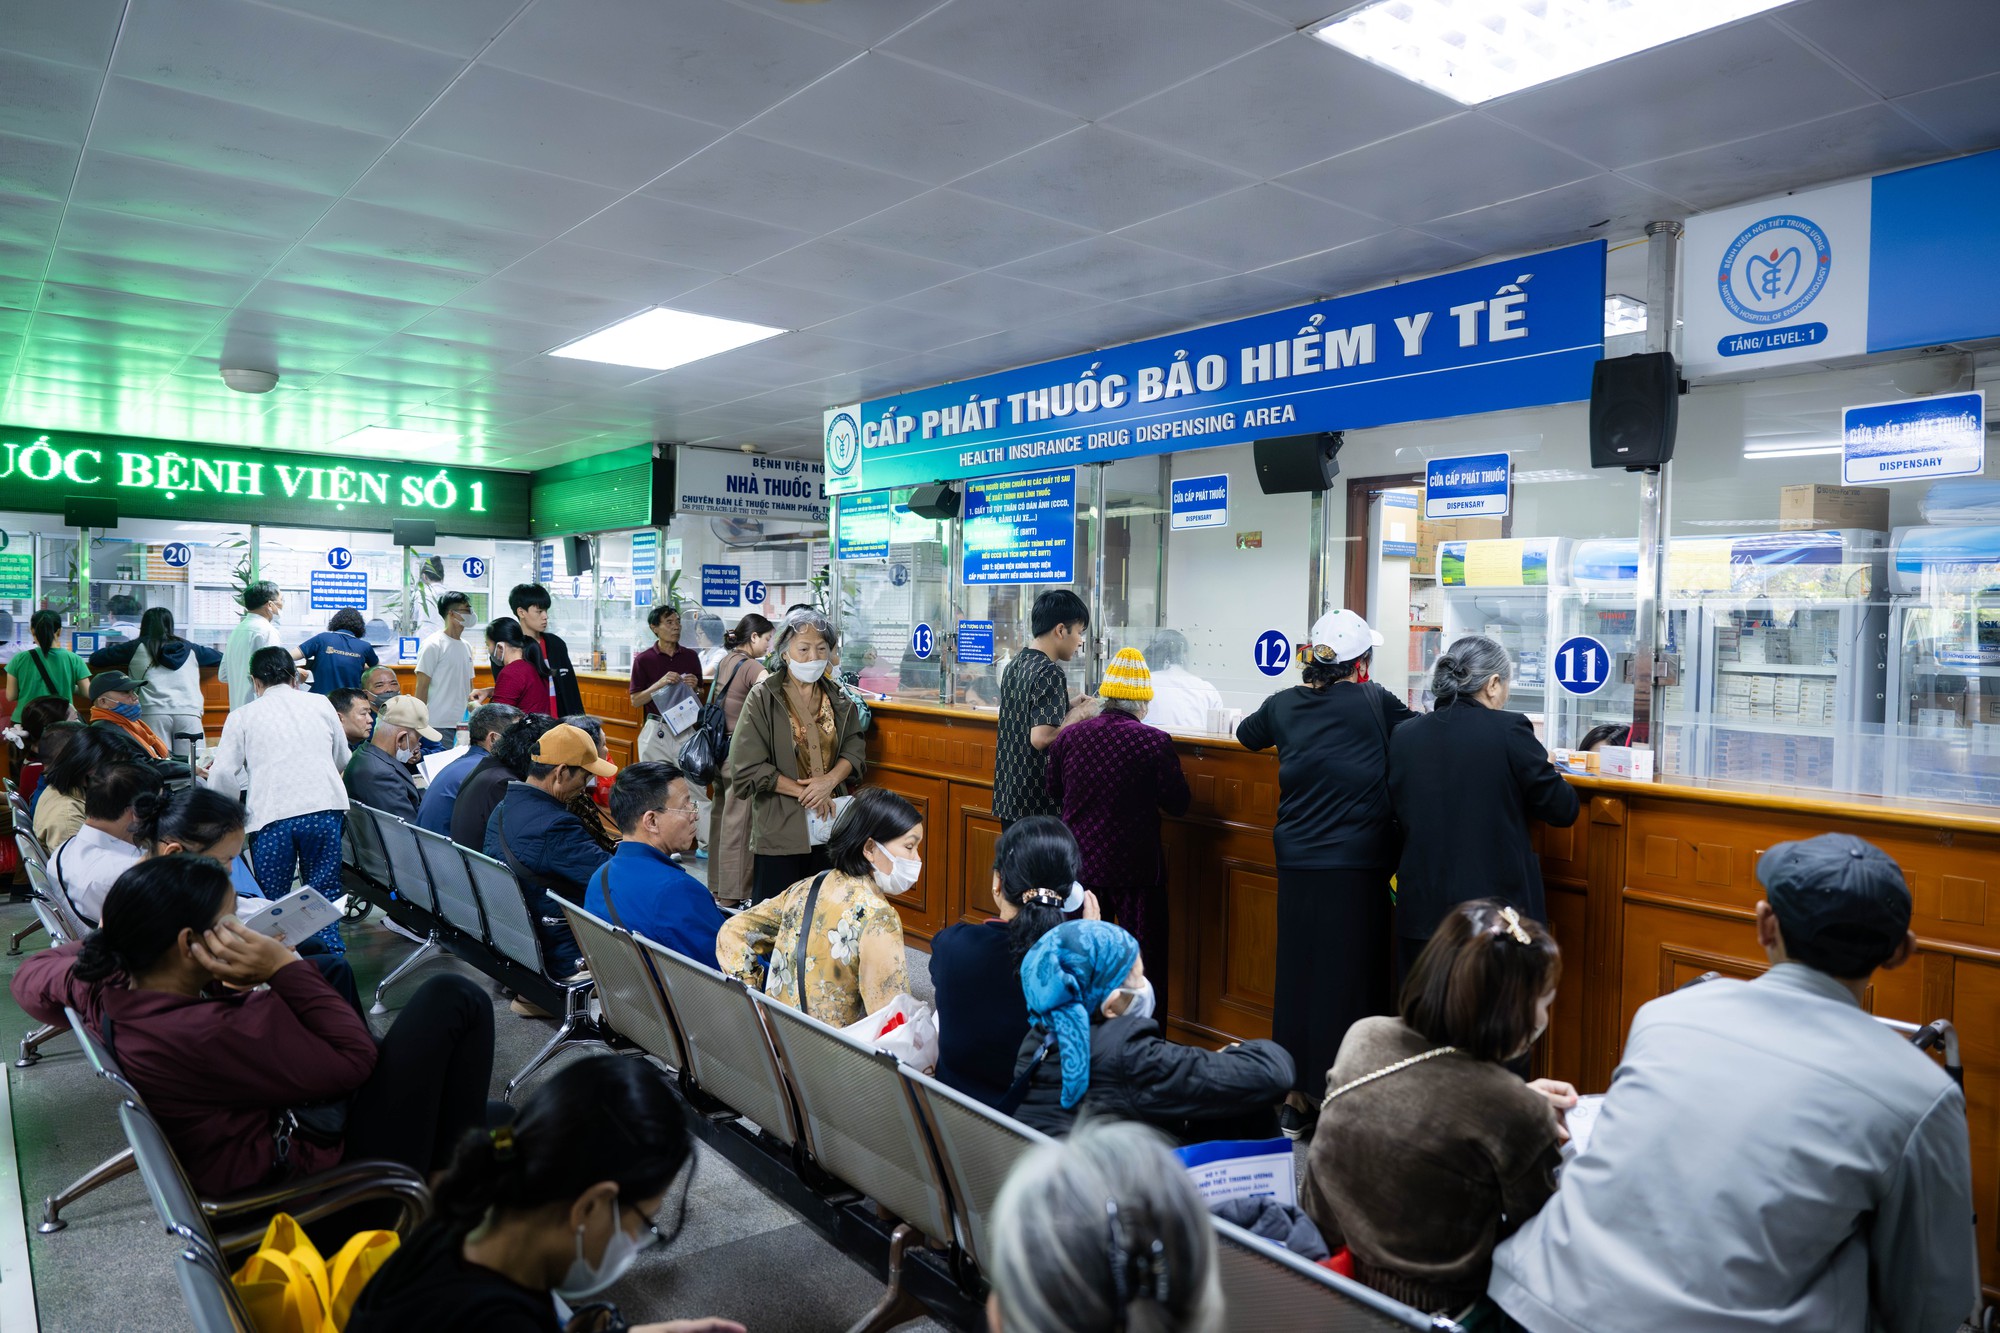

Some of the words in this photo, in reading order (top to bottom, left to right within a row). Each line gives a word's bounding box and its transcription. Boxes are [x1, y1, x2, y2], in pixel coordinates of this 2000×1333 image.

[1721, 284, 1740, 313] NATIONAL
[1739, 310, 1771, 321] HOSPITAL
[1772, 312, 1782, 320] OF
[1783, 266, 1827, 317] ENDOCRINOLOGY
[1766, 331, 1805, 347] LEVEL:
[1808, 328, 1815, 340] 1
[863, 405, 916, 448] CẤP
[922, 394, 1001, 439] PHÁT
[1007, 361, 1127, 424] THUỐC
[1138, 349, 1227, 403] BẢO
[1241, 314, 1376, 385] HIỂM
[1393, 311, 1433, 357] Y
[1450, 273, 1535, 347] TẾ
[960, 446, 1004, 467] HEALTH
[1009, 436, 1082, 460] INSURANCE
[1087, 428, 1130, 450] DRUG
[1136, 412, 1236, 443] DISPENSING
[1243, 404, 1296, 428] AREA
[753, 457, 781, 471] BỆNH
[785, 460, 809, 473] VIỆN
[1880, 457, 1943, 471] DISPENSARY
[117, 452, 265, 500] BỆNH
[273, 465, 390, 511] VIỆN
[401, 469, 457, 509] SỐ
[469, 481, 487, 512] 1
[1429, 471, 1444, 487] CỬA
[1445, 470, 1460, 486] CẤP
[1461, 470, 1480, 485] PHÁT
[1481, 466, 1506, 483] THUỐC
[727, 473, 759, 495] NHÀ
[763, 475, 812, 498] THUỐC
[1174, 490, 1184, 503] CỬA
[1184, 489, 1194, 502] CẤP
[1195, 488, 1208, 501] PHÁT
[1209, 485, 1226, 499] THUỐC
[682, 495, 714, 504] CHUYÊN
[716, 496, 732, 506] BÁN
[772, 500, 796, 511] THÀNH
[1446, 500, 1485, 510] DISPENSARY
[1186, 514, 1212, 522] DISPENSARY
[166, 548, 190, 563] 20
[330, 550, 351, 566] 19
[463, 560, 483, 575] 18
[891, 568, 907, 581] 14
[572, 579, 580, 596] 17
[747, 584, 765, 600] 15
[915, 629, 931, 652] 13
[1258, 638, 1287, 668] 12
[1560, 647, 1600, 683] 11
